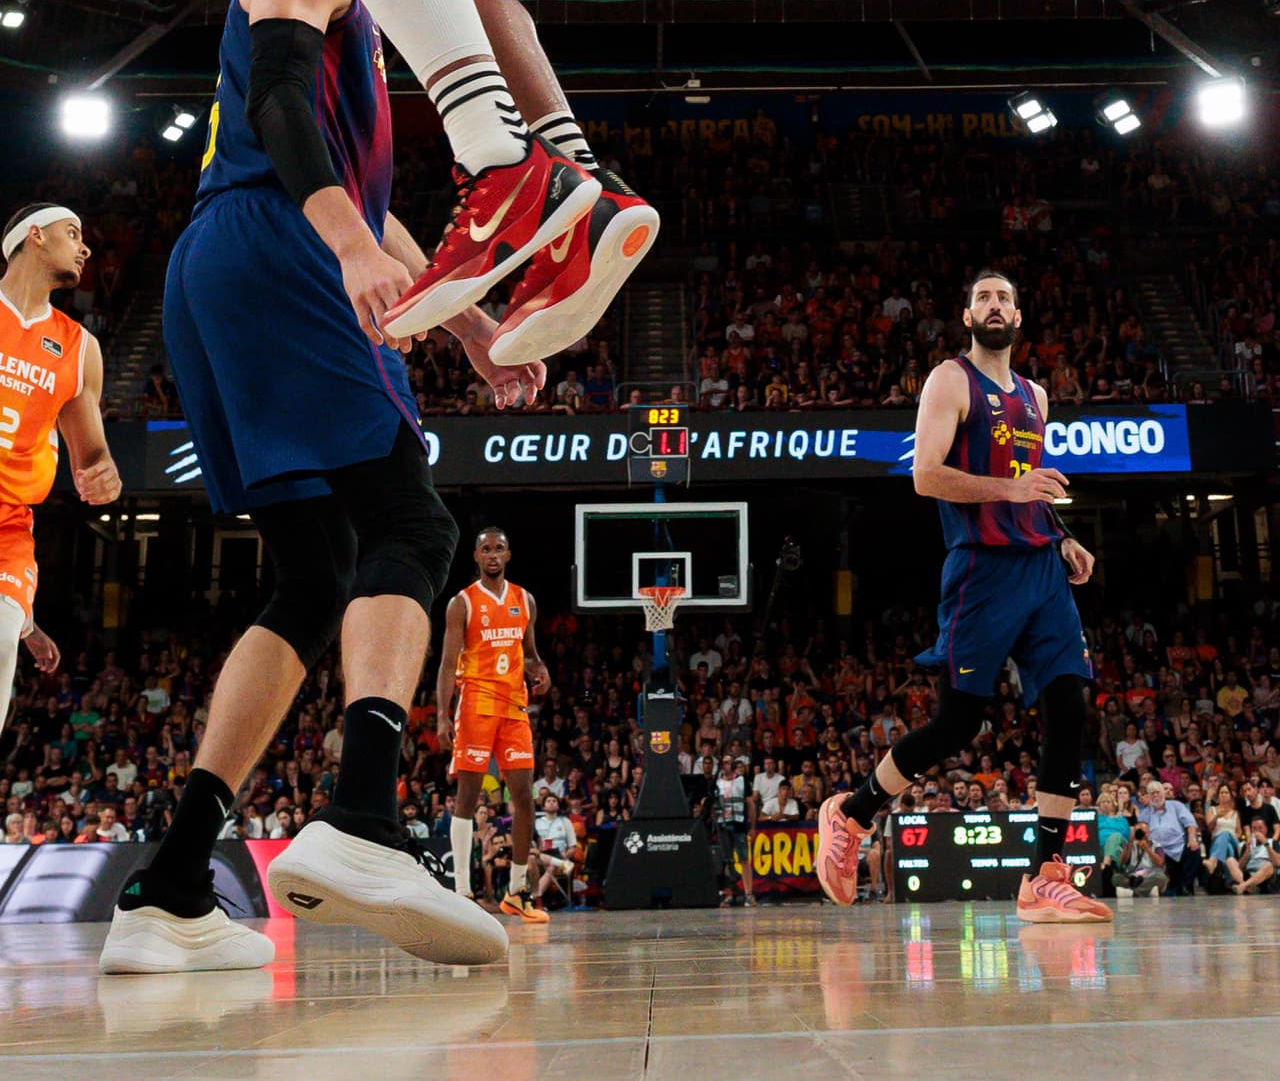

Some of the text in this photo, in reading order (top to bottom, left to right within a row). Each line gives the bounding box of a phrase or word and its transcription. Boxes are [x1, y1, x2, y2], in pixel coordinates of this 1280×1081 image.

[484, 431, 590, 463] CŒUR
[690, 428, 860, 460] 'AFRIQUE
[1044, 419, 1166, 457] CONGO
[480, 627, 524, 642] VALENCIA
[495, 652, 510, 676] 8
[898, 815, 928, 826] LOCAL
[900, 826, 929, 847] 67
[953, 825, 1003, 846] 8:23
[1022, 827, 1036, 844] 4
[907, 874, 921, 892] 0
